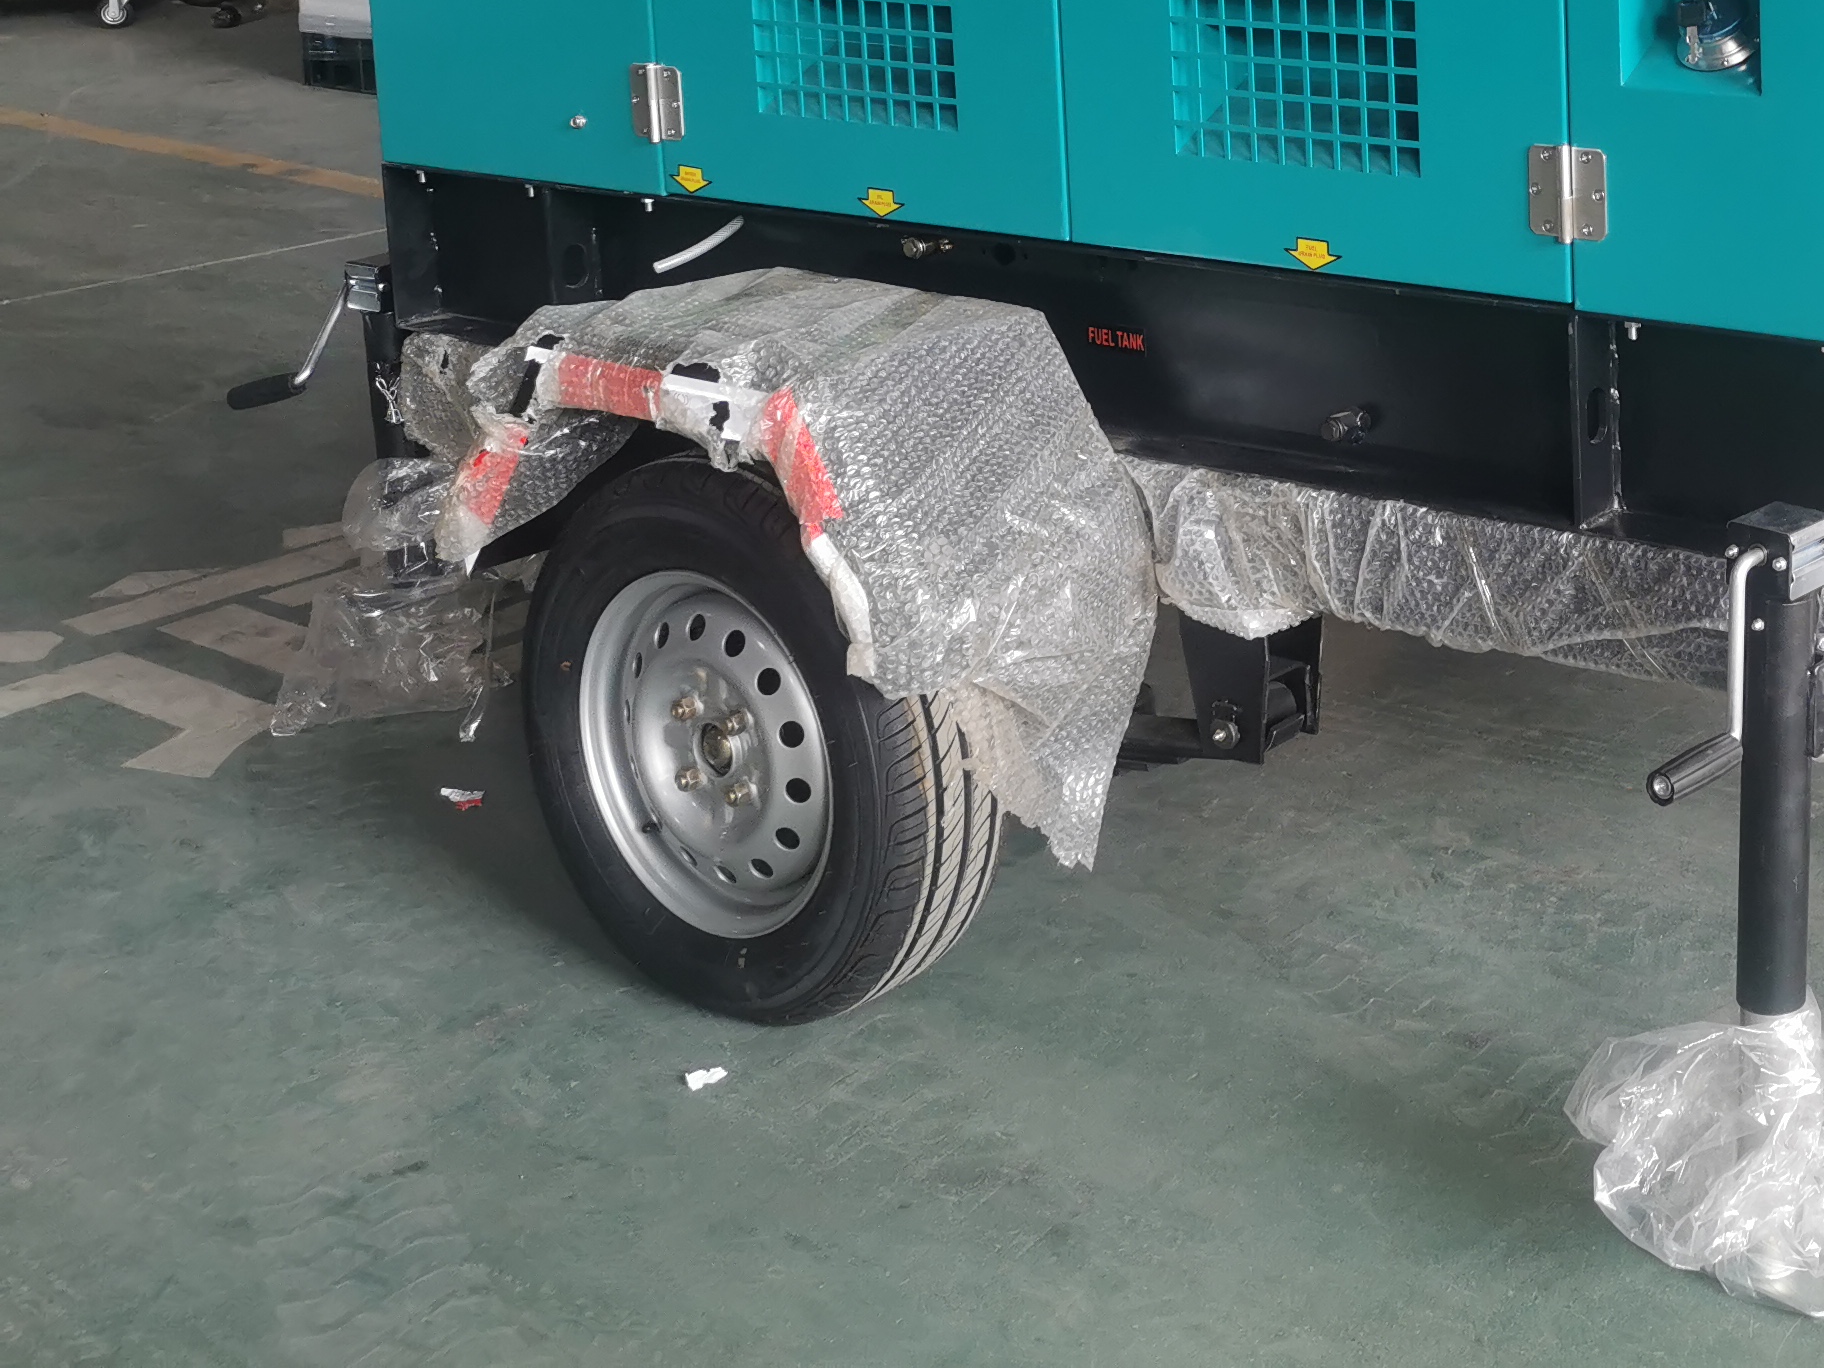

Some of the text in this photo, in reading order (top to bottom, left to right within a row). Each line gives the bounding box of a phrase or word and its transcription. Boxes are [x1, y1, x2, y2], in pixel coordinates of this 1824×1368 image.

[1305, 244, 1317, 252] FUEL
[1313, 252, 1326, 260] PLUG
[1088, 327, 1145, 352] FUEL TANK
